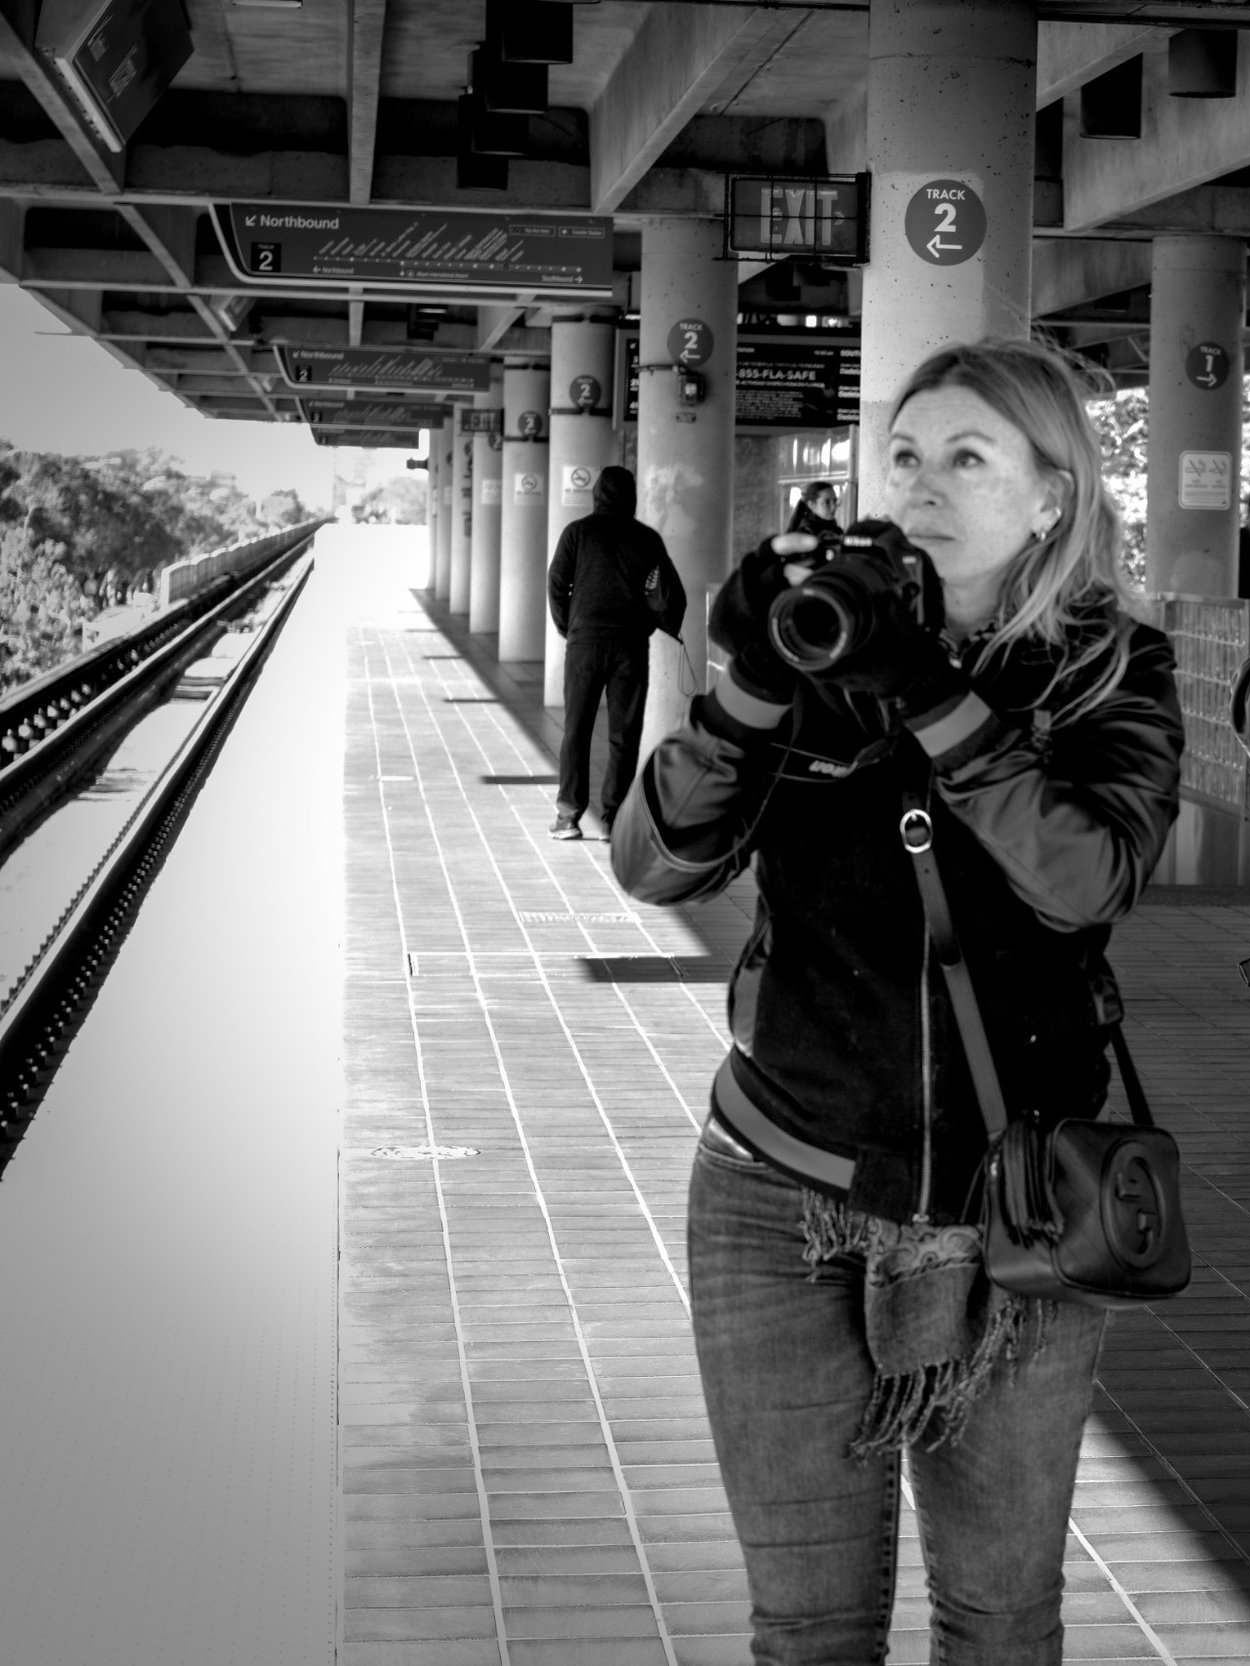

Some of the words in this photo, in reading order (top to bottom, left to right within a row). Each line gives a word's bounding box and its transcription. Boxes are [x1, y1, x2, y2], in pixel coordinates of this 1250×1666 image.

[926, 188, 966, 200] TRACK
[260, 214, 340, 230] Northbound
[760, 187, 838, 246] EXIT
[933, 203, 957, 232] 2
[258, 251, 273, 271] 2
[679, 322, 703, 331] TRACK
[684, 331, 698, 349] 2
[1200, 346, 1221, 355] TRACK
[1206, 354, 1213, 372] 1
[300, 369, 308, 382] 2
[580, 383, 590, 397] 2
[525, 417, 536, 433] 2
